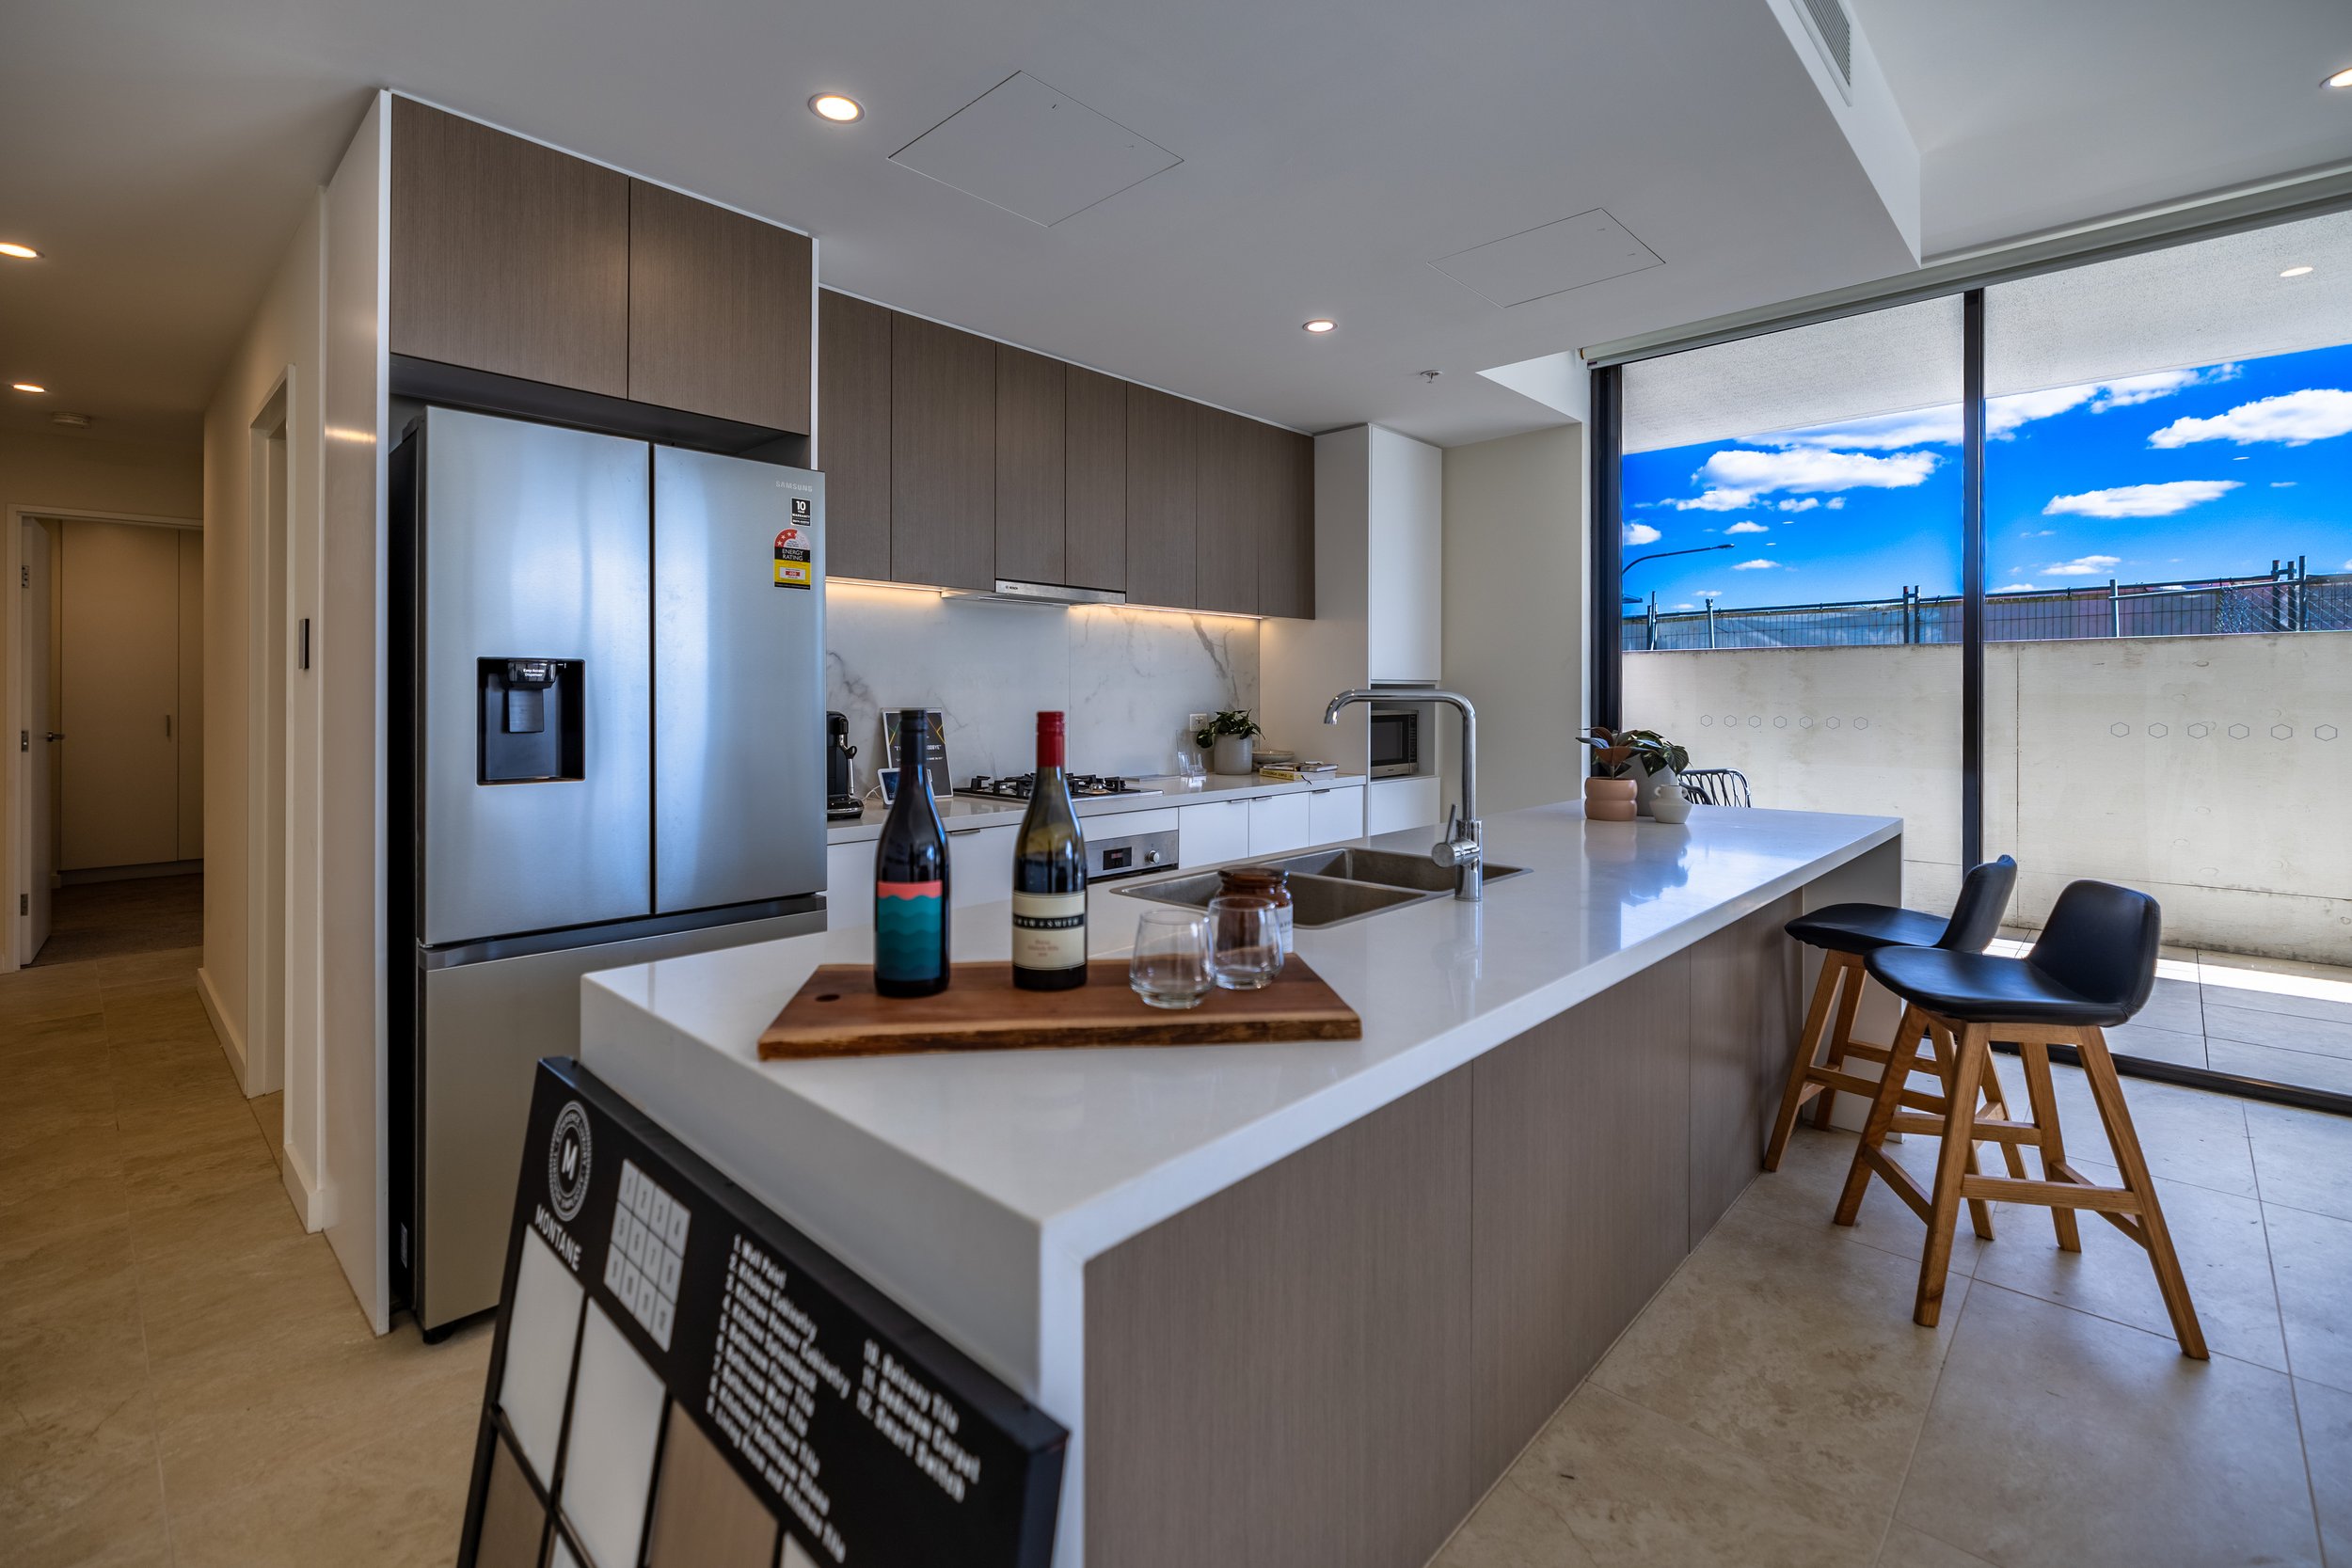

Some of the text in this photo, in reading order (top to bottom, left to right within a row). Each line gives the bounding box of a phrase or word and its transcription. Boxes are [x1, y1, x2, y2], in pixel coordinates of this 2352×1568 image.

[775, 481, 813, 492] SAMSUNG
[796, 500, 806, 511] 10
[533, 1204, 583, 1273] MONTANE
[741, 1240, 763, 1269] Wall
[761, 1256, 787, 1290] Paint
[732, 1302, 766, 1345] Kitchen
[735, 1281, 769, 1323] Kitchen
[801, 1338, 850, 1399] Cabinetry
[738, 1260, 772, 1301] Kitchen
[771, 1288, 818, 1342] Cabinetry
[725, 1342, 767, 1394] Bathroom
[787, 1404, 808, 1437] Tile
[728, 1322, 770, 1372] Bathroom
[794, 1385, 816, 1418] Tile
[882, 1353, 931, 1413] Balcony
[931, 1391, 960, 1435] Tile
[722, 1363, 763, 1417] Bathroom
[799, 1440, 820, 1478] Tile
[874, 1404, 915, 1458] Smart
[914, 1439, 966, 1504] Switch
[878, 1378, 933, 1442] Bedroom
[931, 1423, 981, 1485] Carpet
[765, 1463, 785, 1494] and
[783, 1480, 823, 1538] Kitchen
[821, 1521, 846, 1563] Tile
